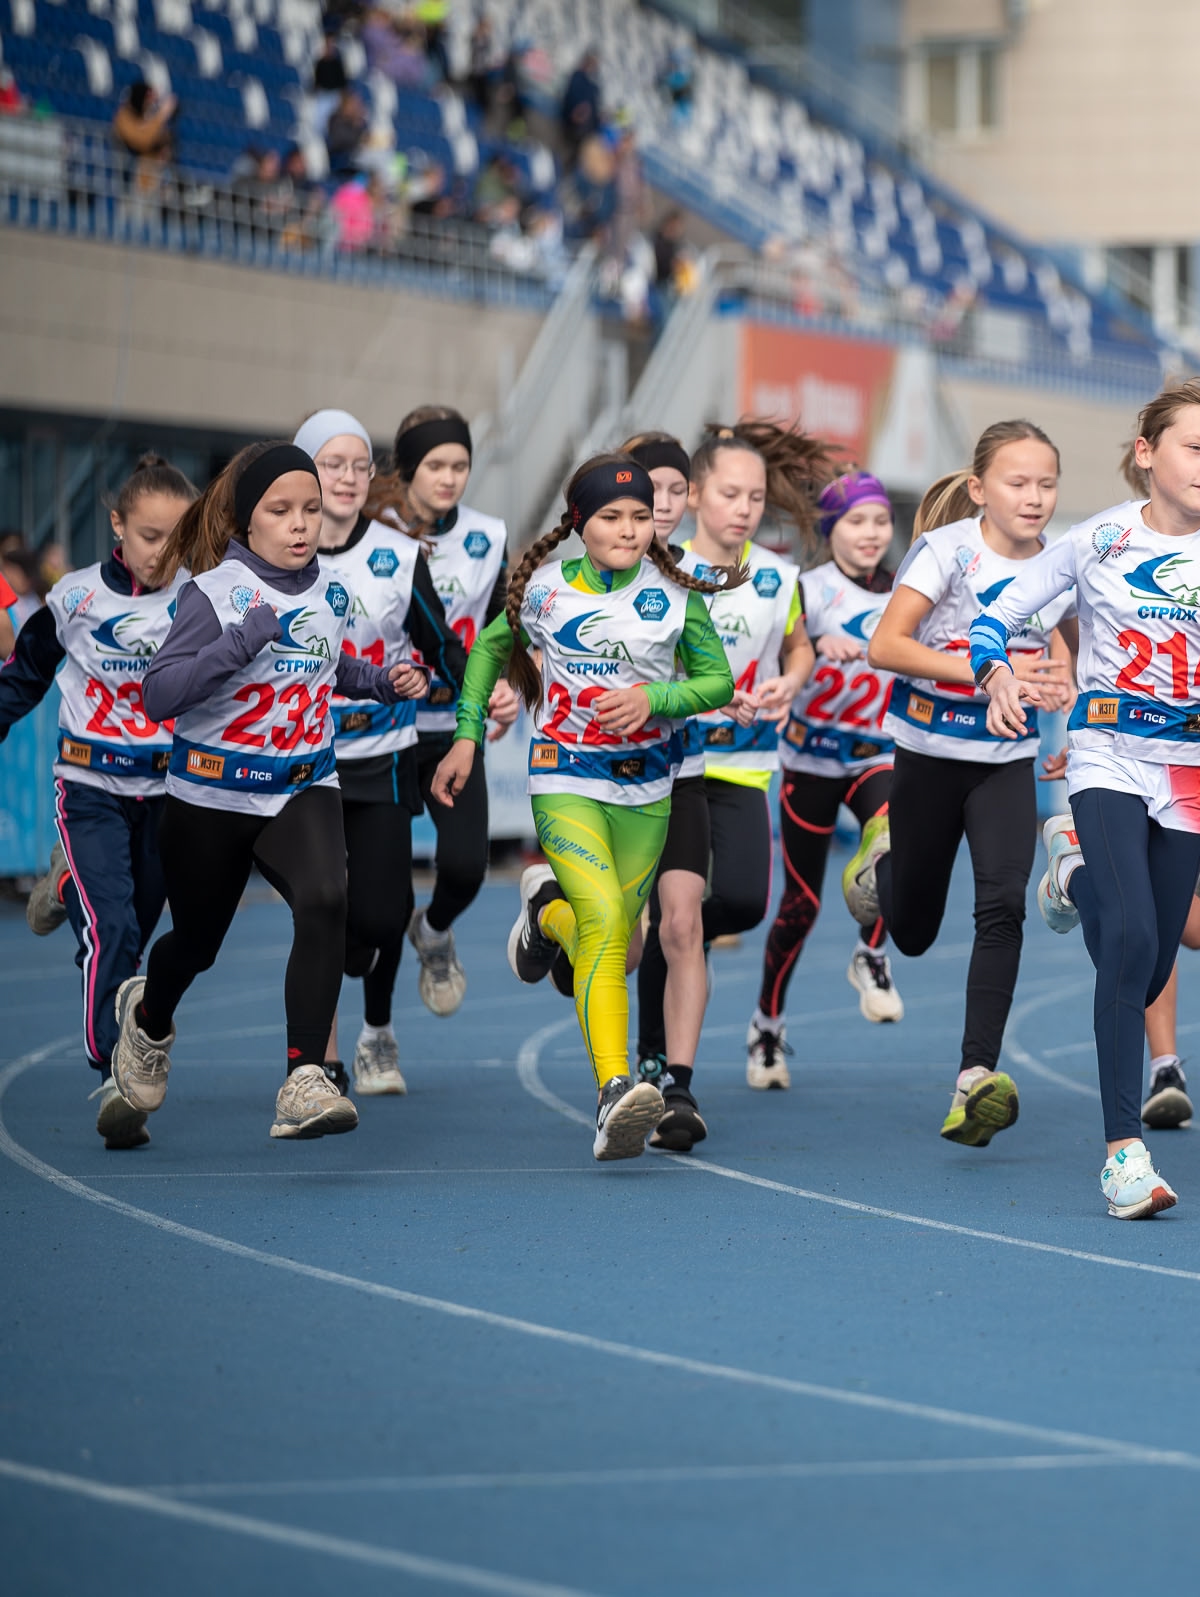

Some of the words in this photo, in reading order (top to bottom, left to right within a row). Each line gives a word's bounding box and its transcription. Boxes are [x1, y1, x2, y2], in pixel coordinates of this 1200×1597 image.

[1137, 605, 1198, 624] СТРИЖ
[274, 660, 323, 674] СТРИЖ
[566, 662, 620, 676] СТРИЖ
[804, 665, 895, 731] 22
[85, 678, 176, 738] 23
[221, 682, 333, 751] 233
[954, 714, 976, 727] ПСБ
[1143, 713, 1167, 726] ПСБ
[250, 770, 273, 782] ПСБ
